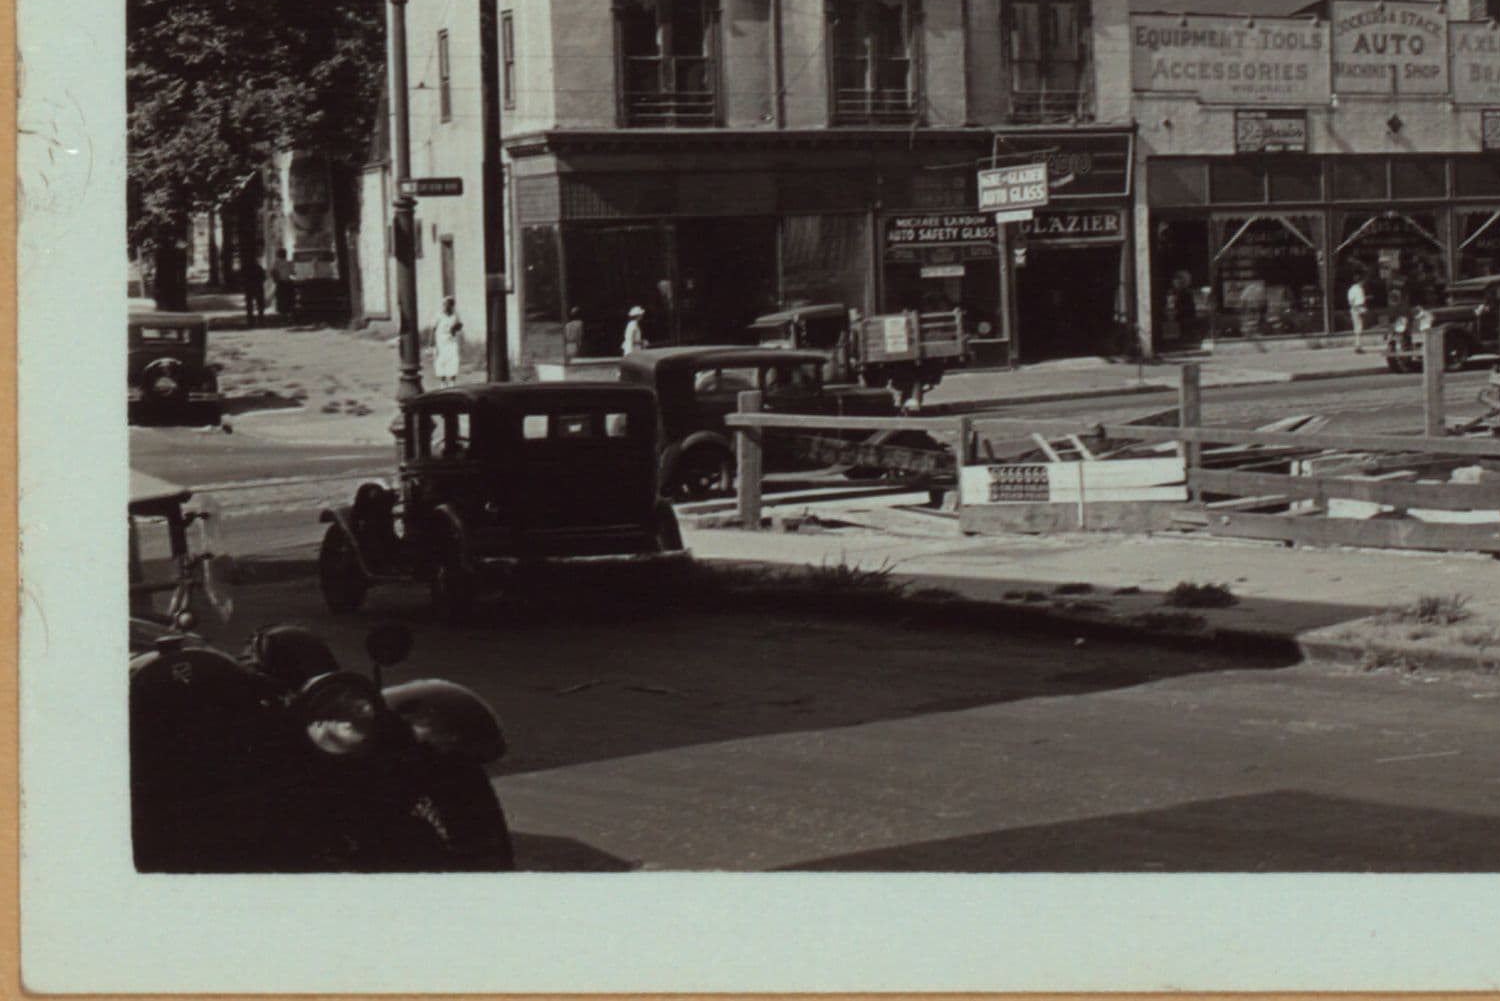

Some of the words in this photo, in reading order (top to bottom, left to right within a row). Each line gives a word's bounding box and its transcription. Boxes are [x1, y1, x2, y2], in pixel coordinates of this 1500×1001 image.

[1258, 28, 1322, 49] TOOLS
[1352, 33, 1425, 55] AUTO
[1152, 58, 1309, 81] ACCESSORIES
[1009, 183, 1045, 202] GLASS
[918, 227, 959, 240] SAFETY
[961, 227, 996, 239] GLASS
[1018, 215, 1119, 234] GLAZIER
